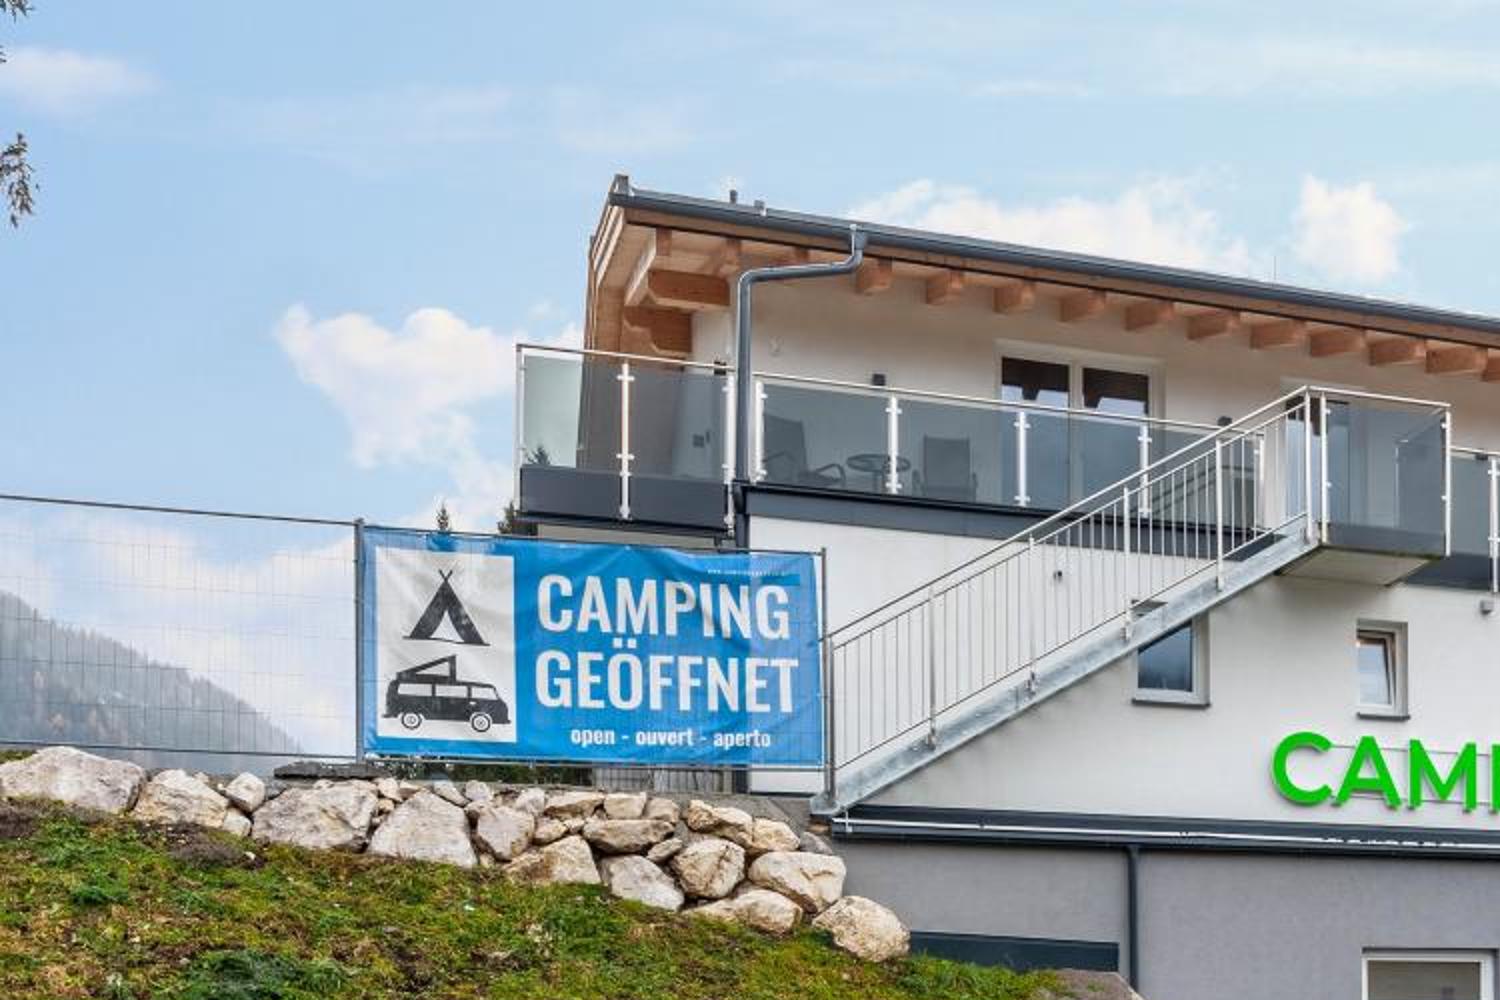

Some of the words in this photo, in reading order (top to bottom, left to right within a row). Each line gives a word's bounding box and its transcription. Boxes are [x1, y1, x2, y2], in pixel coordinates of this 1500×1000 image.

[536, 573, 790, 641] CAMPING
[535, 638, 800, 714] GEÖFFNET
[571, 728, 616, 748] open
[635, 729, 694, 746] ouvert
[713, 729, 772, 750] aperto
